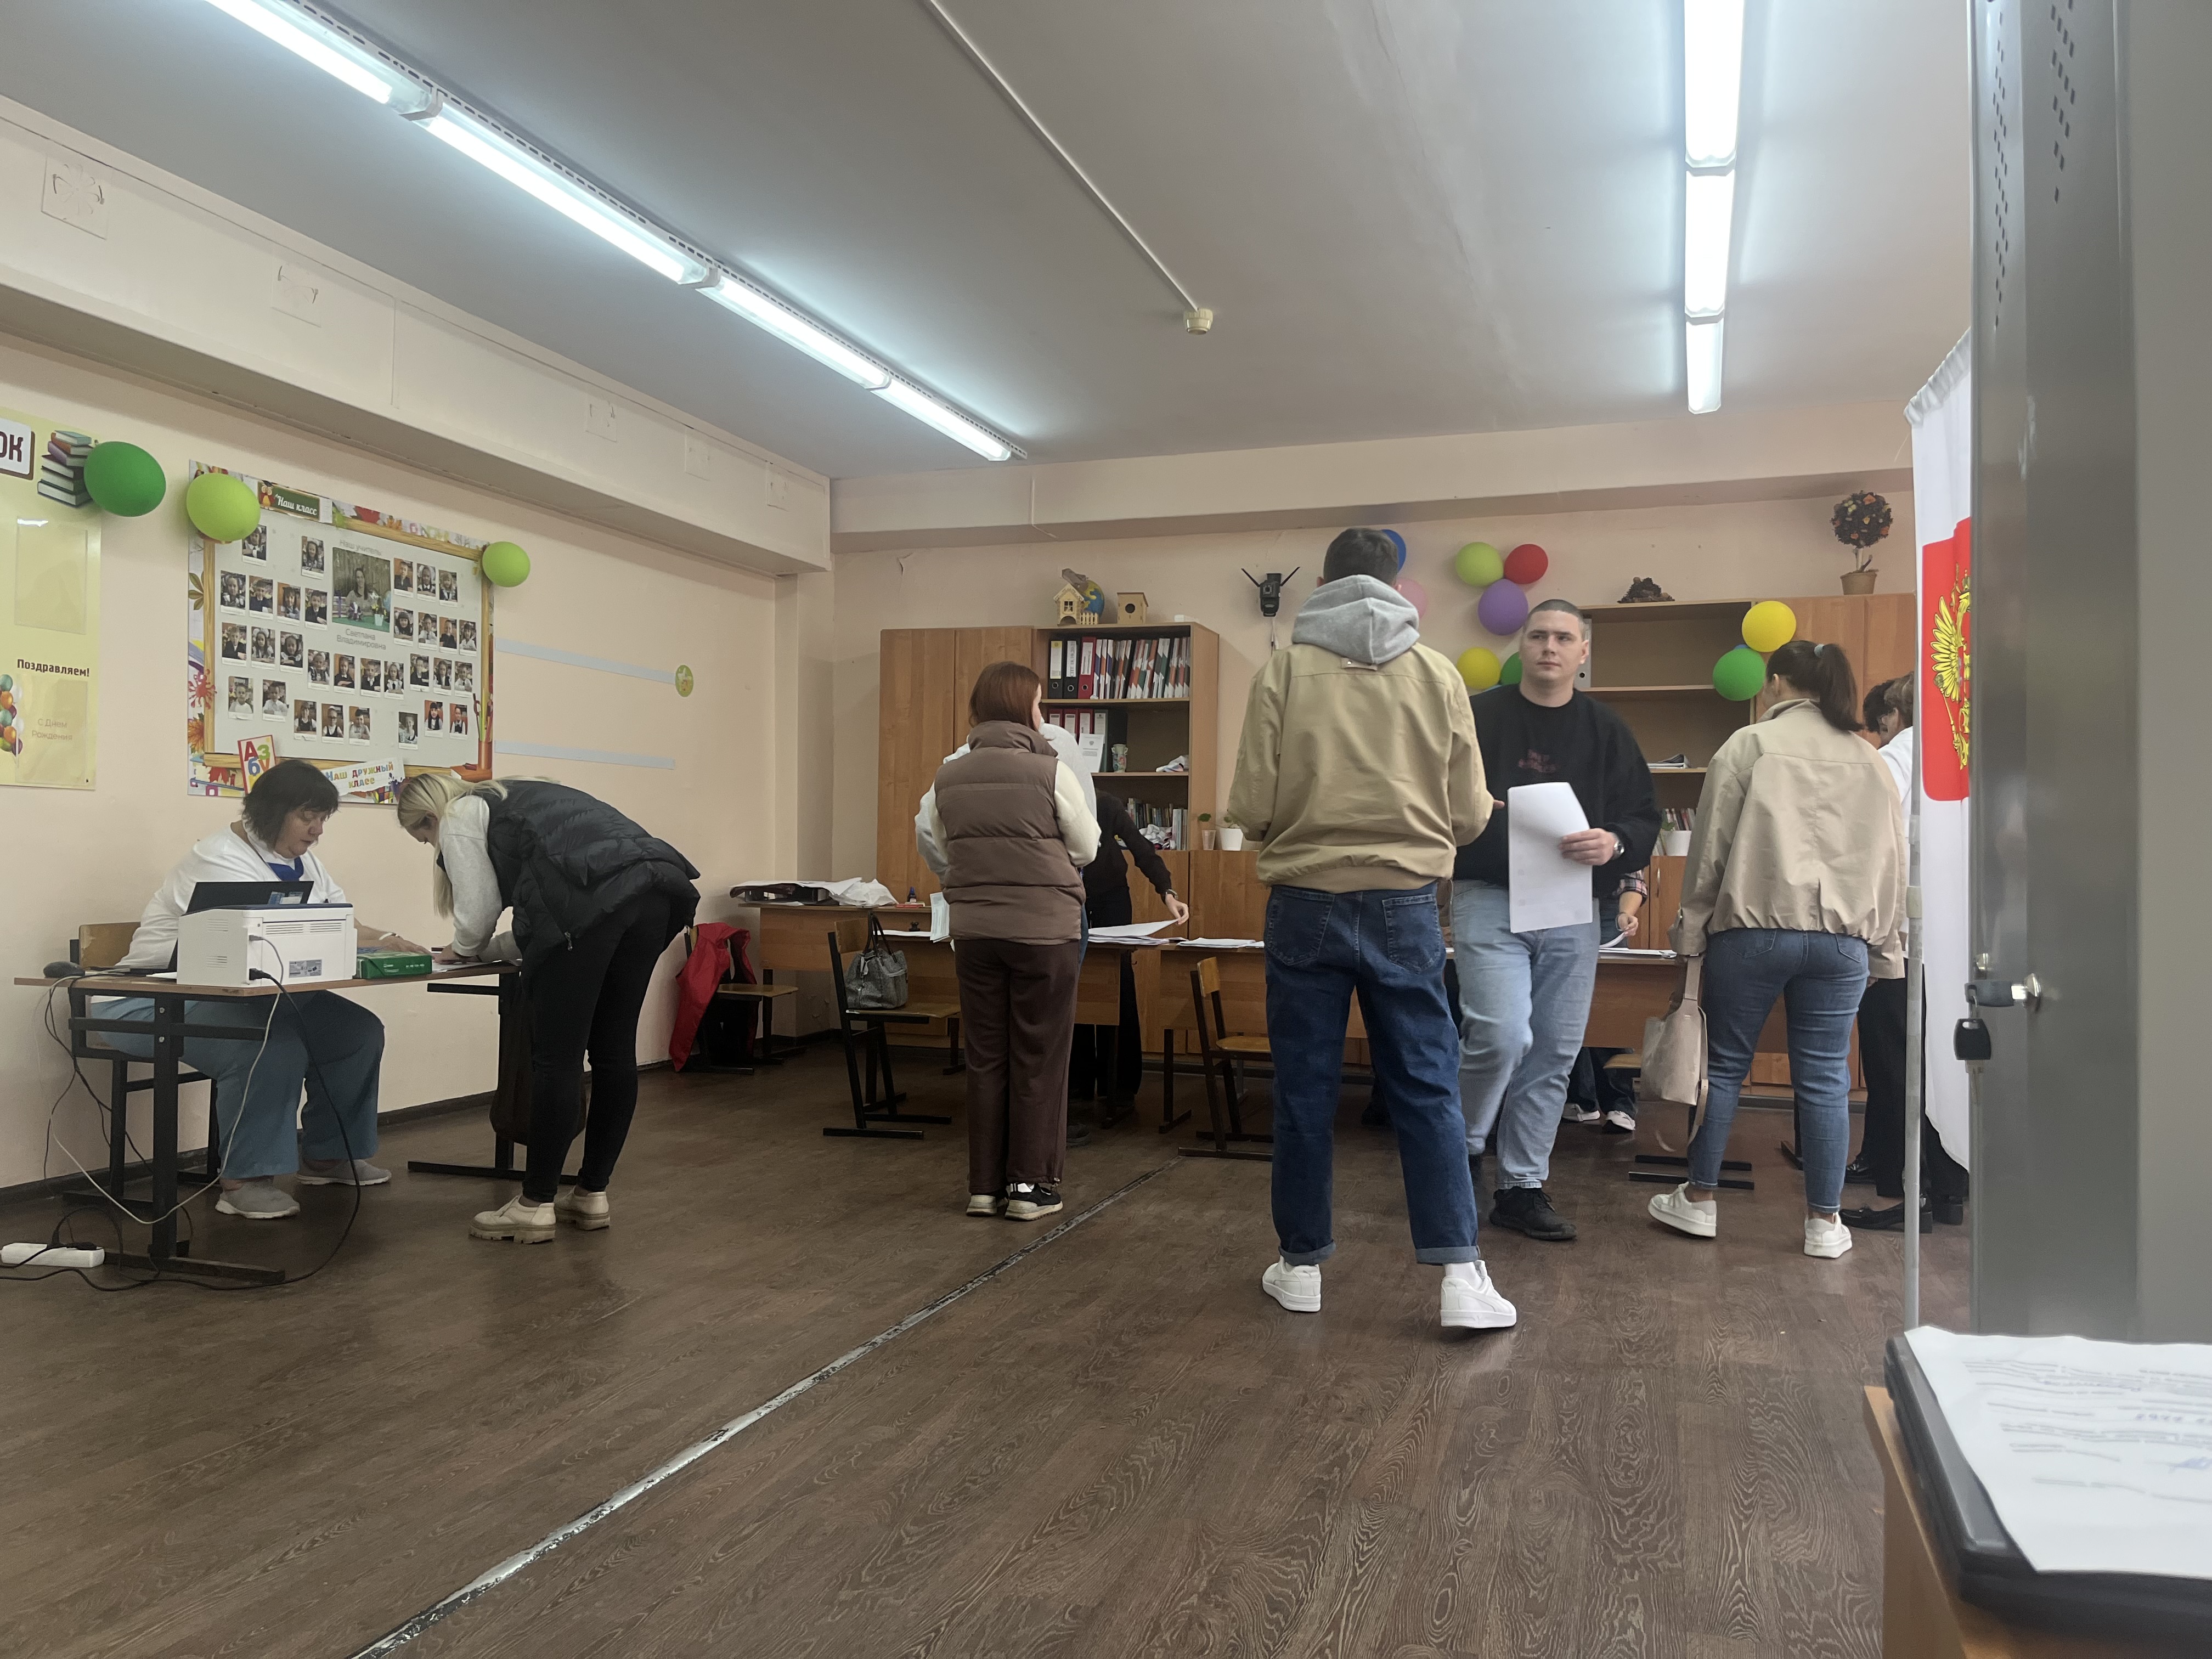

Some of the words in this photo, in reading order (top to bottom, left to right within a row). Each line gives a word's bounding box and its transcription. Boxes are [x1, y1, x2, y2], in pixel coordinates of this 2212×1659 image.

[275, 494, 295, 509] Наш
[296, 504, 318, 515] класс
[346, 628, 376, 641] Светлана
[337, 635, 386, 650] Владимировна
[17, 658, 90, 678] Поздравляем!
[45, 719, 67, 728] Днем
[31, 730, 73, 741] Рождения
